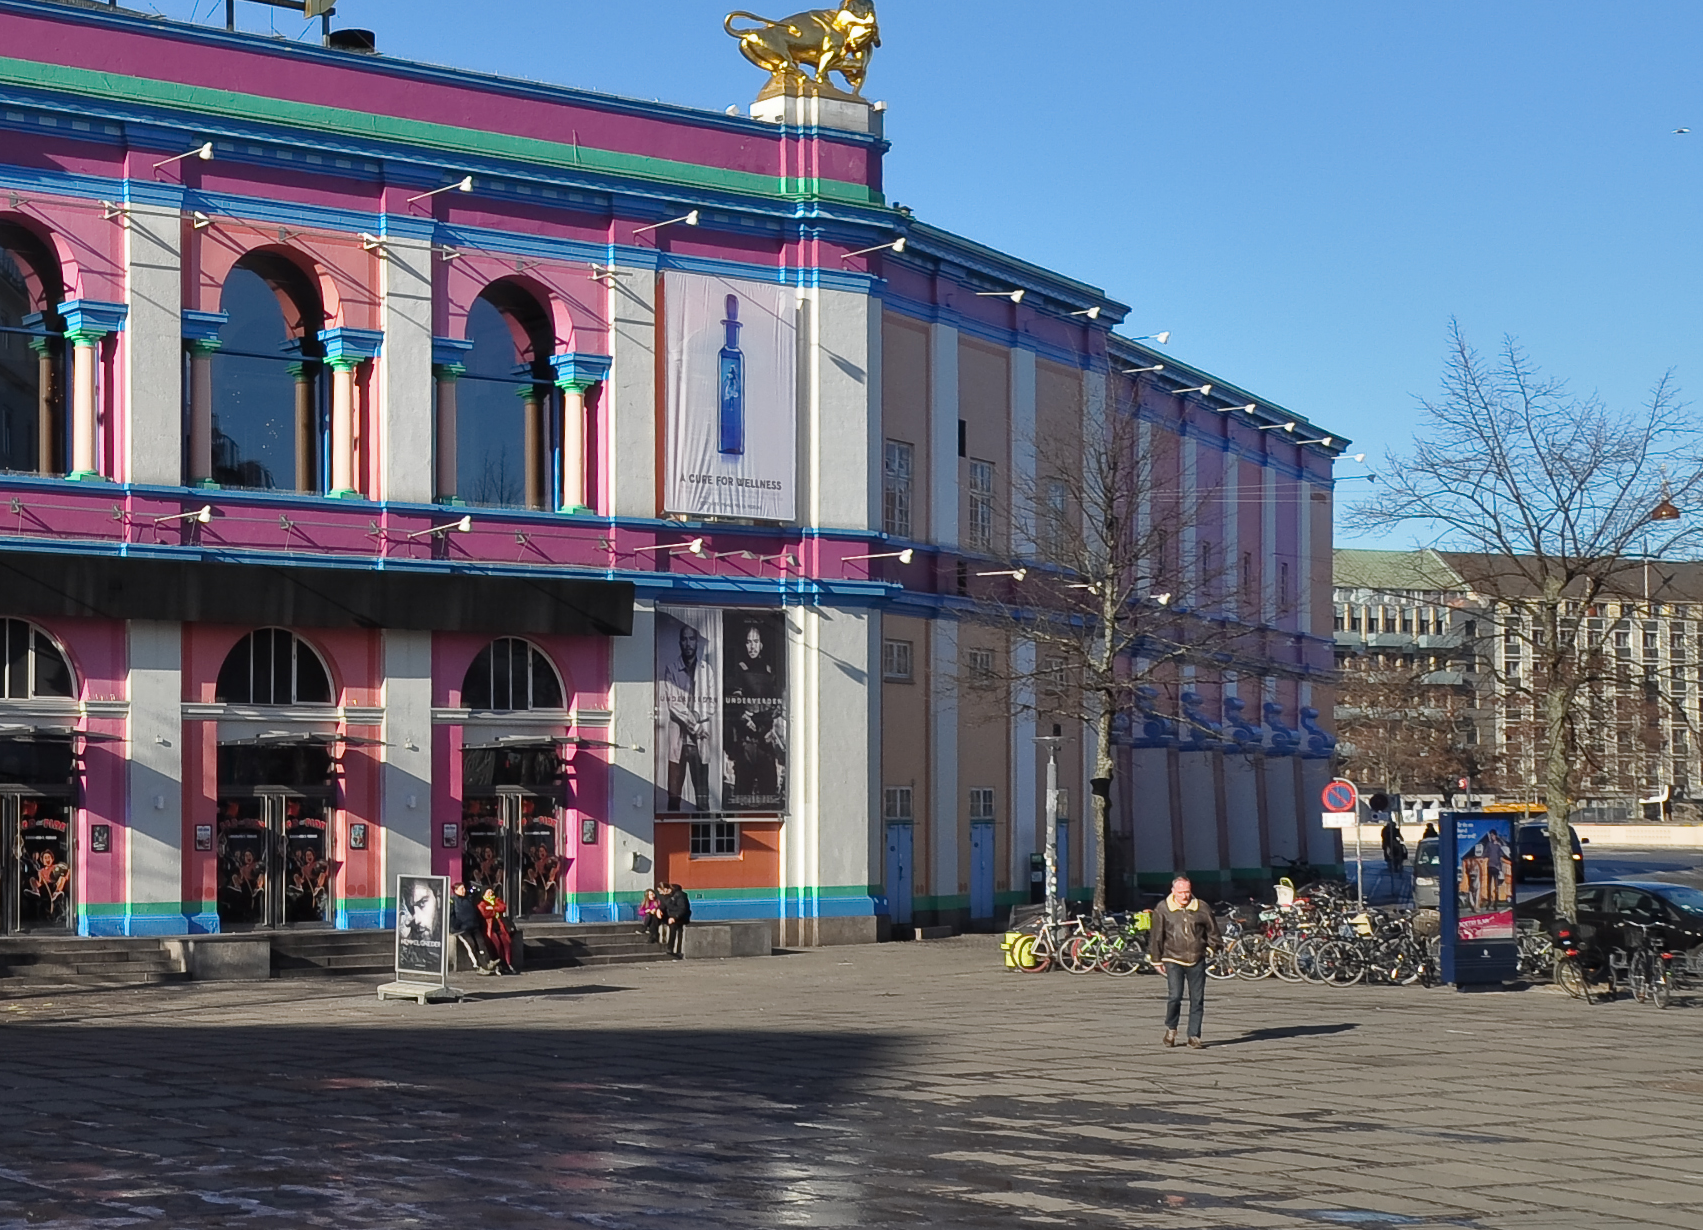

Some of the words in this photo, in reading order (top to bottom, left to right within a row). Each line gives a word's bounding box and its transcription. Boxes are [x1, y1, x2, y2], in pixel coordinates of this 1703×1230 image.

[680, 472, 686, 482] A
[688, 473, 713, 485] CURE
[716, 476, 734, 487] FOR
[736, 477, 782, 491] WELLNESS
[725, 696, 783, 705] UNDERVERDEN
